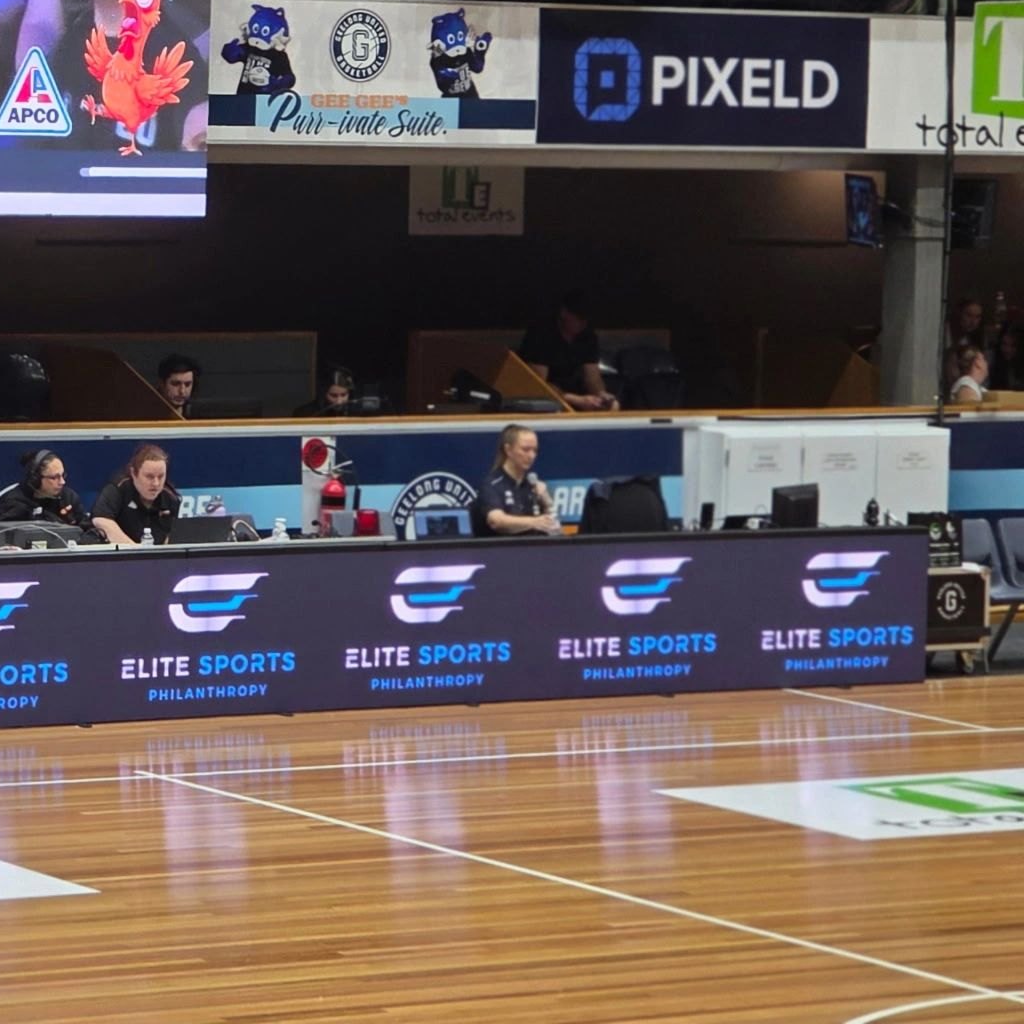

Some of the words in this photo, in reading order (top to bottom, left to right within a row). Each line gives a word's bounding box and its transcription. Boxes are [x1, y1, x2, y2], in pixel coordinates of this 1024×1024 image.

[652, 55, 839, 109] PIXELD
[310, 93, 350, 109] GEE
[7, 107, 60, 124] APCO
[388, 109, 448, 138] Suite.
[395, 479, 441, 526] GEELONG
[558, 636, 621, 659] ELITE
[628, 632, 717, 656] SPORTS
[761, 628, 822, 651] ELITE
[827, 625, 914, 648] SPORTS
[121, 655, 190, 680] ELITE
[198, 651, 296, 676] SPORTS
[345, 645, 411, 669] ELITE
[418, 641, 512, 666] SPORTS
[784, 655, 889, 672] PHILANTHROPY
[370, 673, 485, 691] PHILANTHROPY
[582, 663, 691, 681] PHILANTHROPY
[148, 683, 268, 702] PHILANTHROPY
